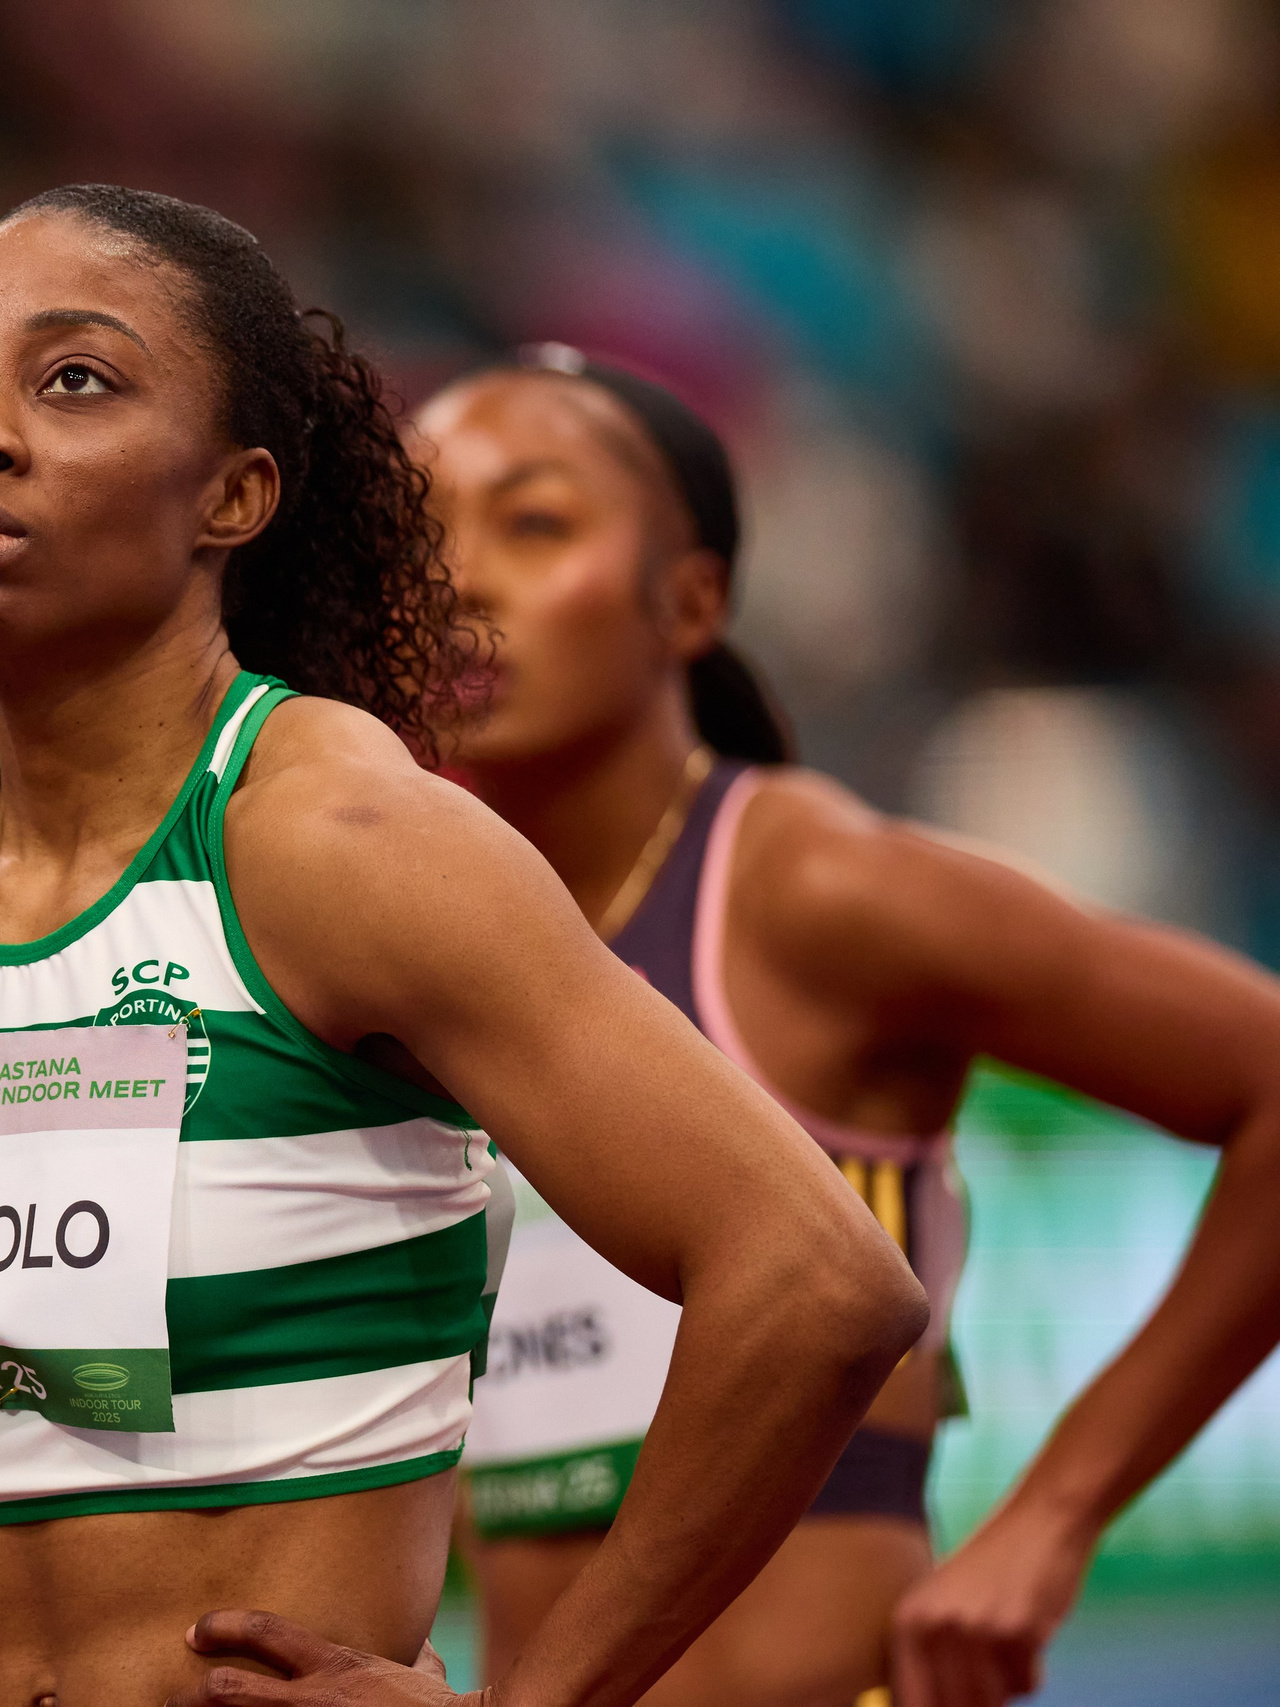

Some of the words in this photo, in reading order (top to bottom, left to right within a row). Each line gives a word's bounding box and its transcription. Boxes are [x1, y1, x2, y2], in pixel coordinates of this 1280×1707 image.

[111, 959, 190, 996] SCP
[105, 998, 192, 1032] PORTIN
[89, 1079, 166, 1099] MEET
[0, 1361, 48, 1400] 25
[68, 1398, 109, 1410] INDOOR
[111, 1399, 141, 1411] TOUR
[91, 1411, 121, 1424] 2025
